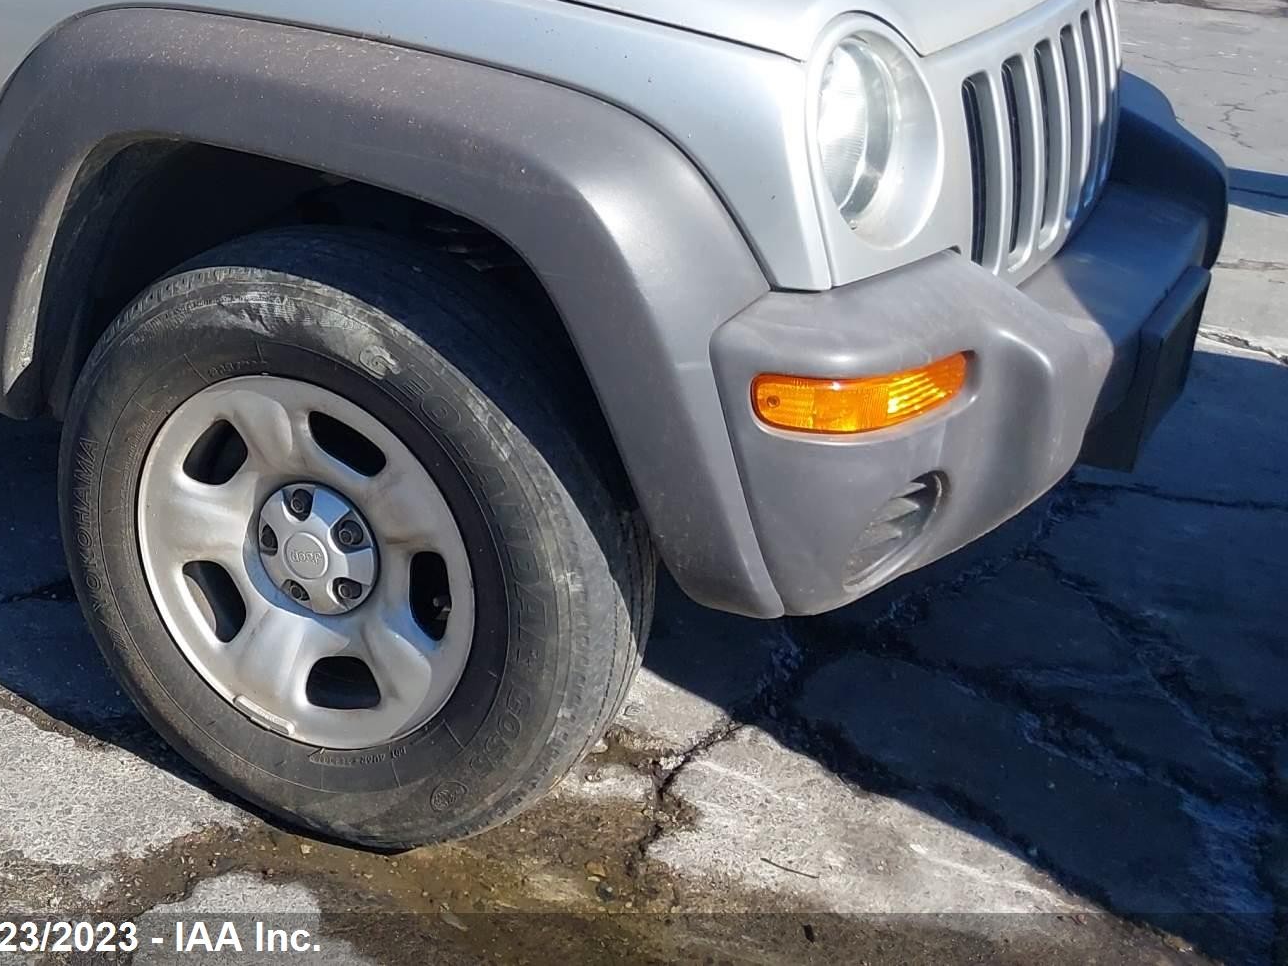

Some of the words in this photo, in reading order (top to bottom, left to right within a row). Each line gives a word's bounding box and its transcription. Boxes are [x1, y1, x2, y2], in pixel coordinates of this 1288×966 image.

[73, 437, 109, 613] YOKOHAMA
[289, 550, 322, 567] Jeep
[359, 345, 548, 674] GEOLANDAR
